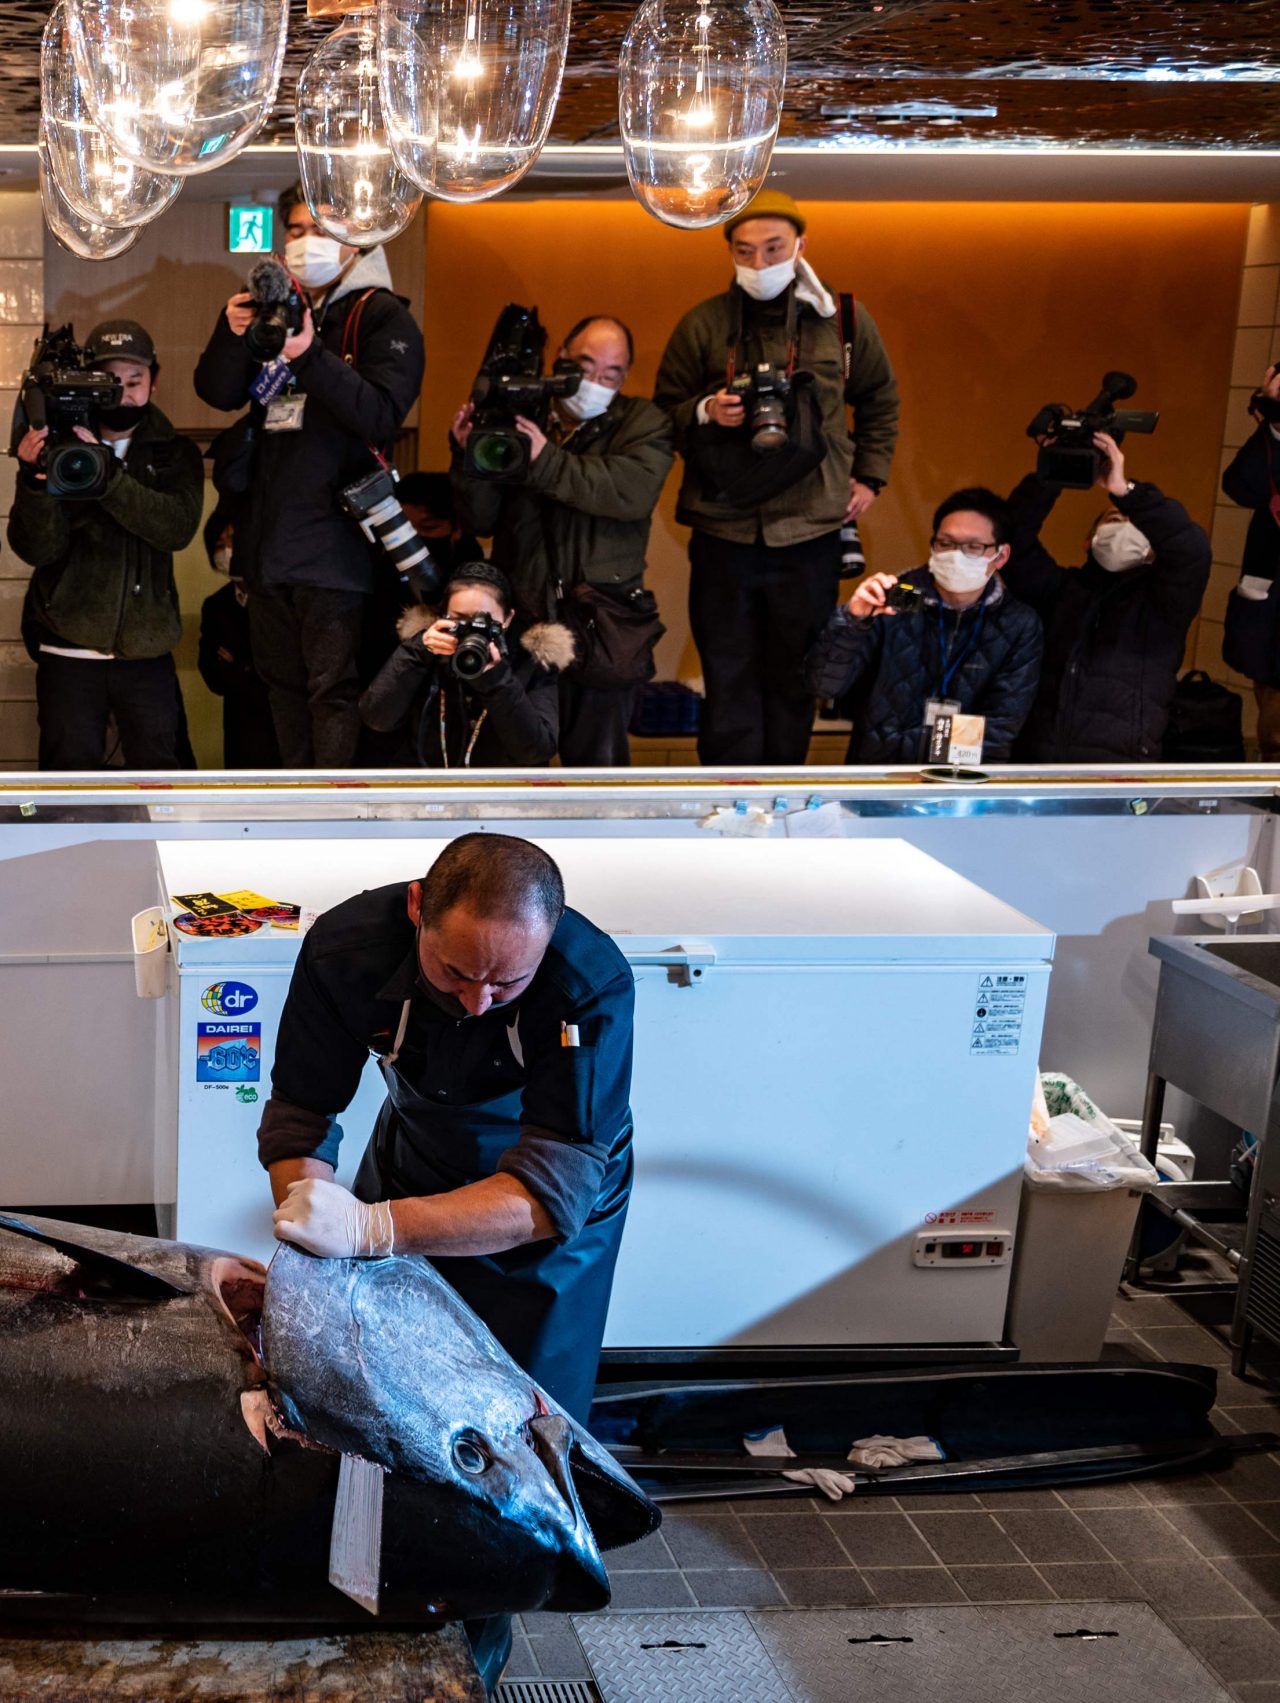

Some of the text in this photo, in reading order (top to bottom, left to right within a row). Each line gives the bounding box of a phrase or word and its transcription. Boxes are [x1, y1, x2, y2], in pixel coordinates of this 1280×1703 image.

[259, 371, 287, 406] Reuters
[224, 989, 253, 1008] dr
[205, 1025, 253, 1034] DAIREI
